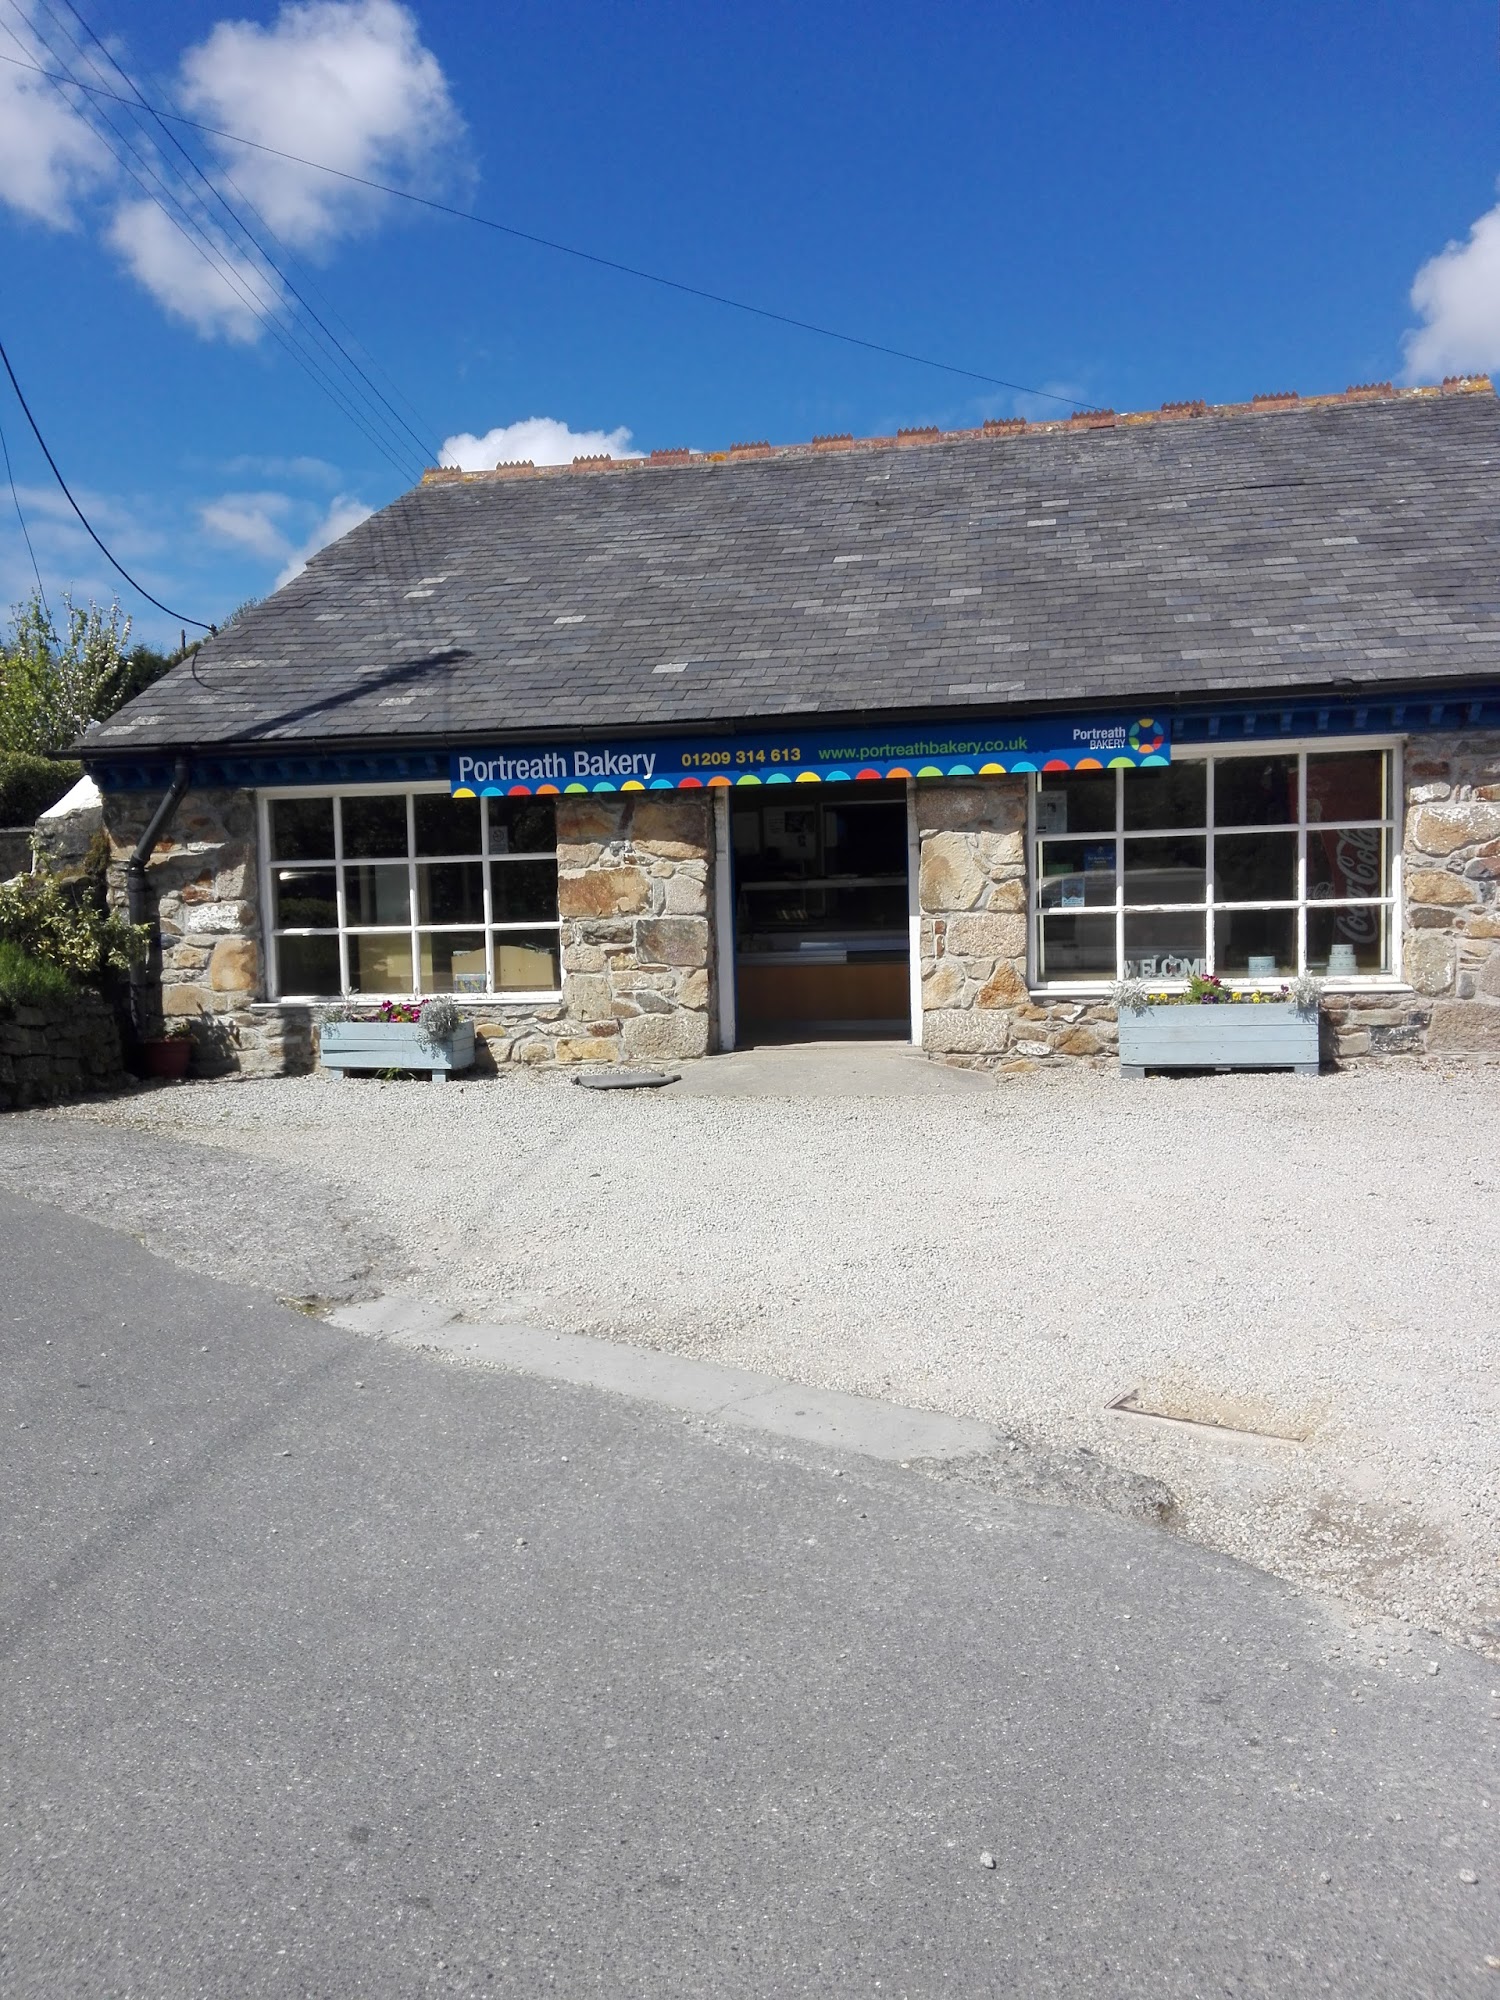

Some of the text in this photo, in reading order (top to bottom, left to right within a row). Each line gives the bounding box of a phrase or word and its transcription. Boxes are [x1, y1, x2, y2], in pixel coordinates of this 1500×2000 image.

[1073, 727, 1126, 740] Portreath
[818, 737, 1028, 760] www.portreathbakery.co.uk
[1089, 738, 1126, 750] BAKERY
[458, 750, 656, 782] Portreath Bakery
[681, 748, 801, 767] 01209 314 613
